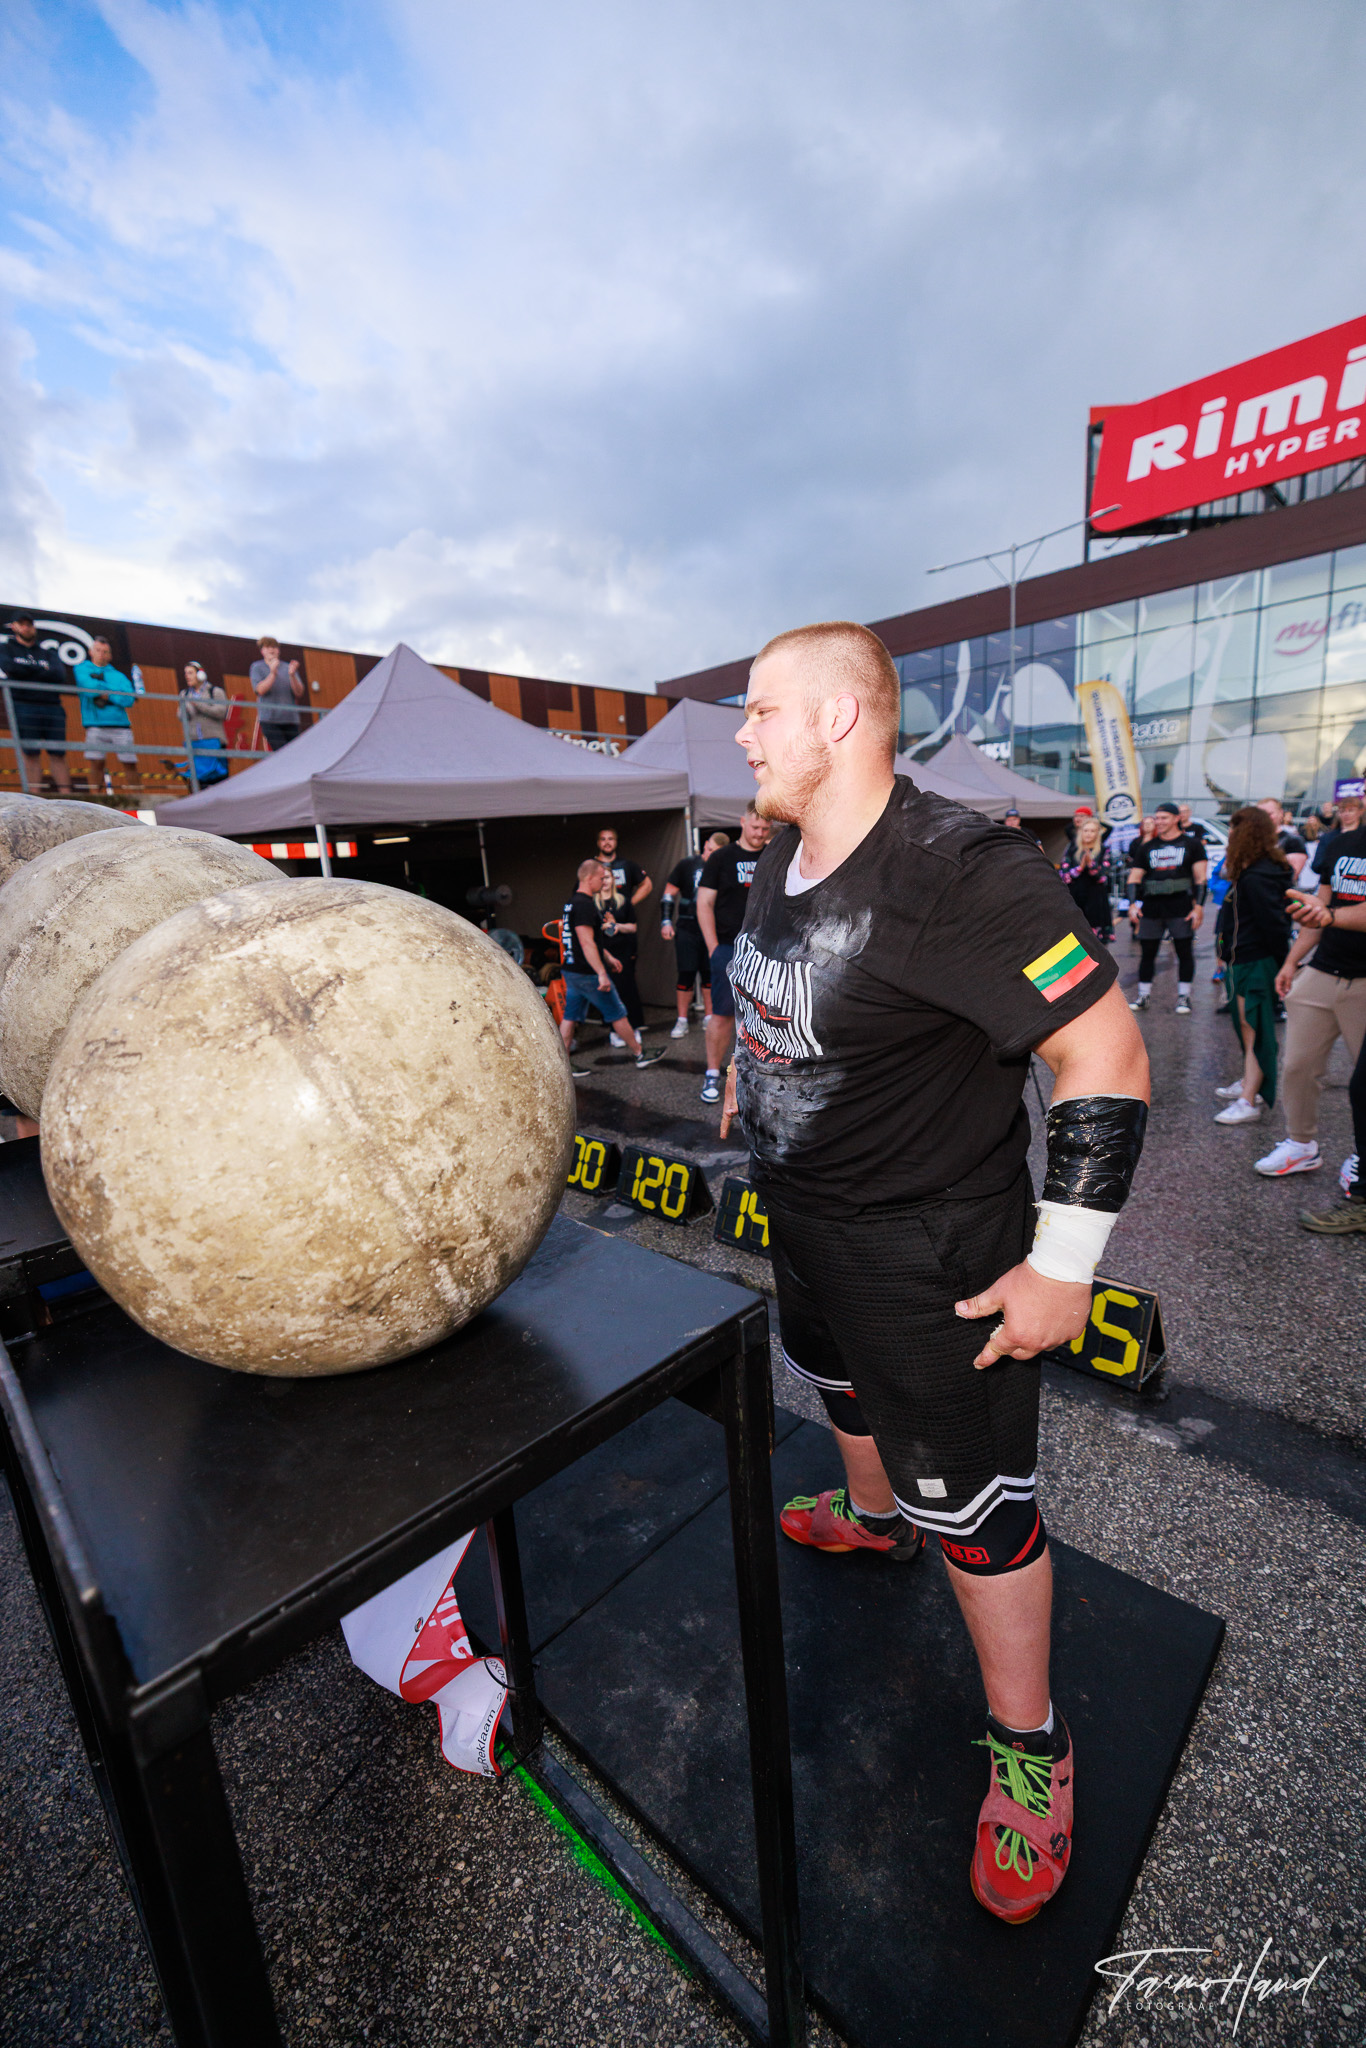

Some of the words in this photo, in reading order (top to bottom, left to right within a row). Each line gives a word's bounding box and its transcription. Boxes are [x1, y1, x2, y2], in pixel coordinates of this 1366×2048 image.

[1224, 417, 1361, 479] HYPER
[631, 1152, 690, 1219] 120
[1069, 1288, 1141, 1377] 5
